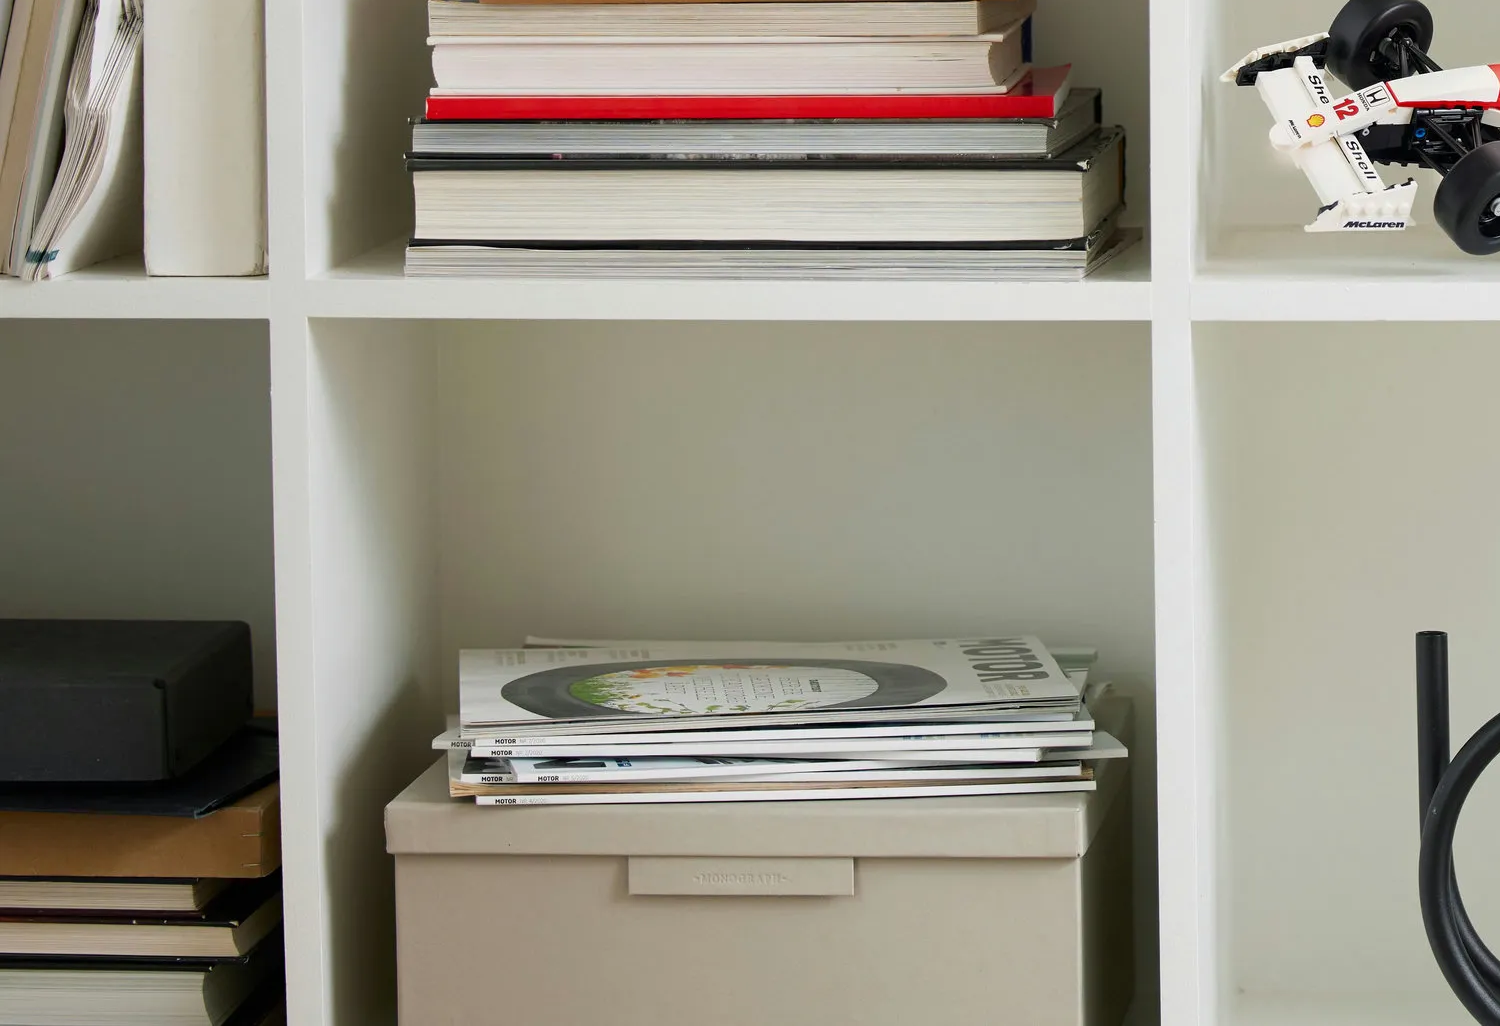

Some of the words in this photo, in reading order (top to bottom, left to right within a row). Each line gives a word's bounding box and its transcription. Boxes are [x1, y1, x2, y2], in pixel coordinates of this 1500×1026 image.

[1308, 74, 1330, 105] She
[1356, 92, 1370, 112] HONDA
[1333, 98, 1359, 121] 12
[1345, 140, 1377, 179] Shell
[1343, 221, 1405, 229] McLaren
[957, 636, 1051, 683] MOTOR
